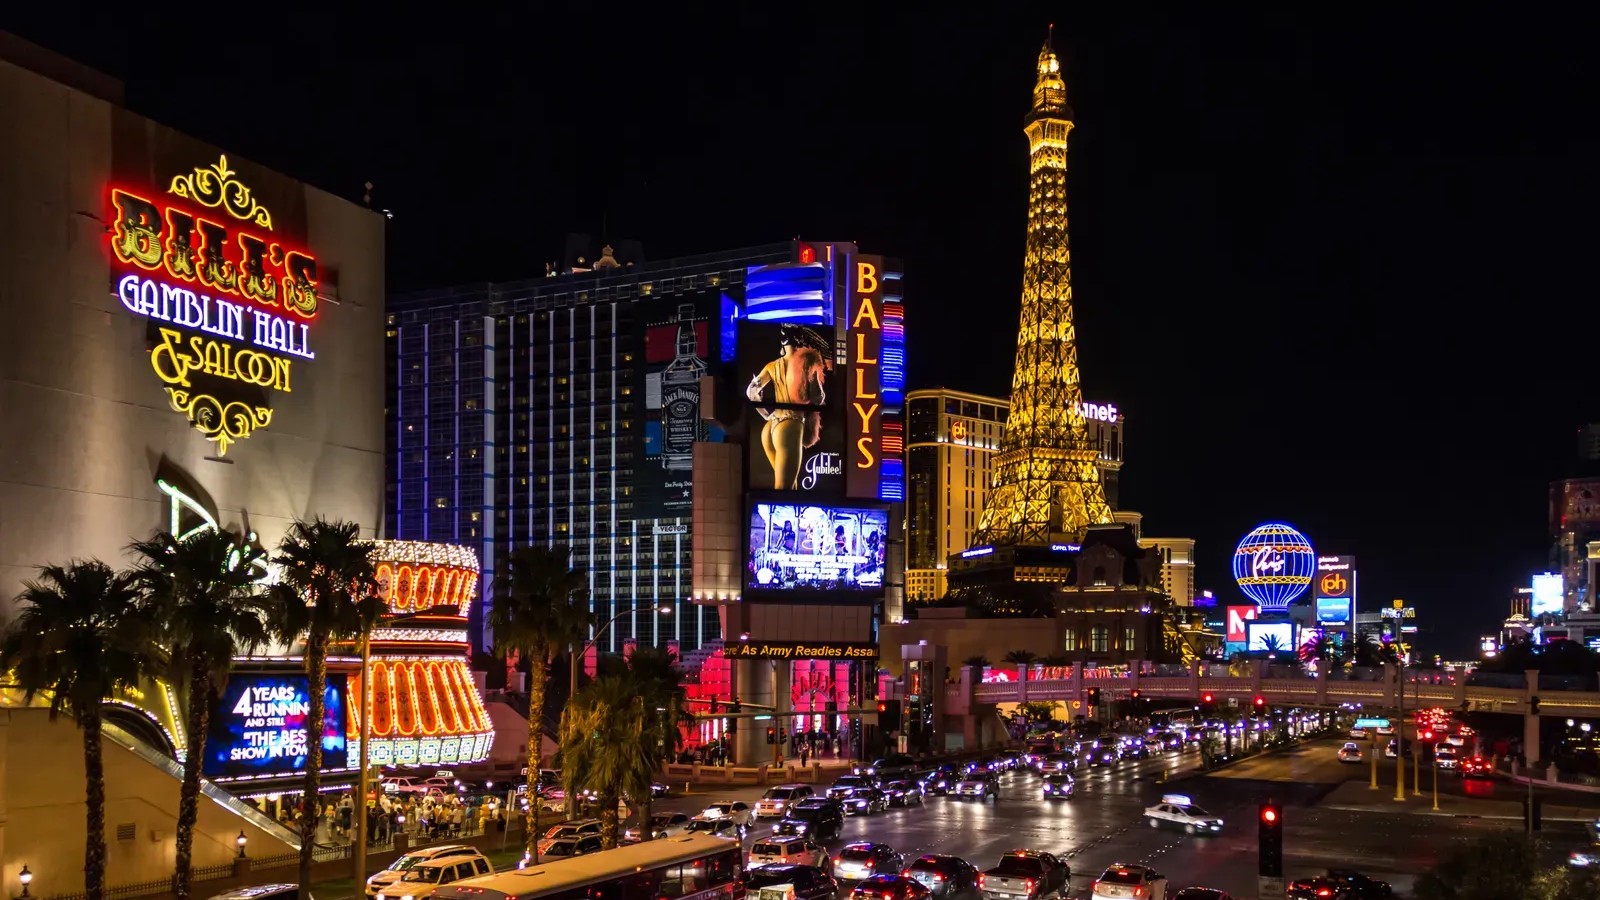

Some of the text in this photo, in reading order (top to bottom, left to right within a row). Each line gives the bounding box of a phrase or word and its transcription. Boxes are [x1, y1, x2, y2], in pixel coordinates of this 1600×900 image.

[111, 188, 317, 318] BILL'S
[118, 275, 315, 359] GAMBLIN' HALL
[151, 327, 291, 392] & SALOON
[853, 262, 880, 468] BALLYS
[1075, 402, 1117, 423] anet
[802, 453, 842, 490] Jubilee!
[660, 525, 686, 533] VECTOR
[1252, 545, 1285, 580] Paris
[1324, 573, 1347, 593] ph
[741, 645, 757, 655] As
[759, 645, 792, 658] Army
[795, 645, 842, 657] Readies
[232, 686, 295, 717] 4 YEARS
[253, 701, 310, 717] RUNNIN
[244, 717, 286, 728] AND STILL
[281, 729, 308, 745] BES
[230, 744, 308, 760] SHOW IN TOW
